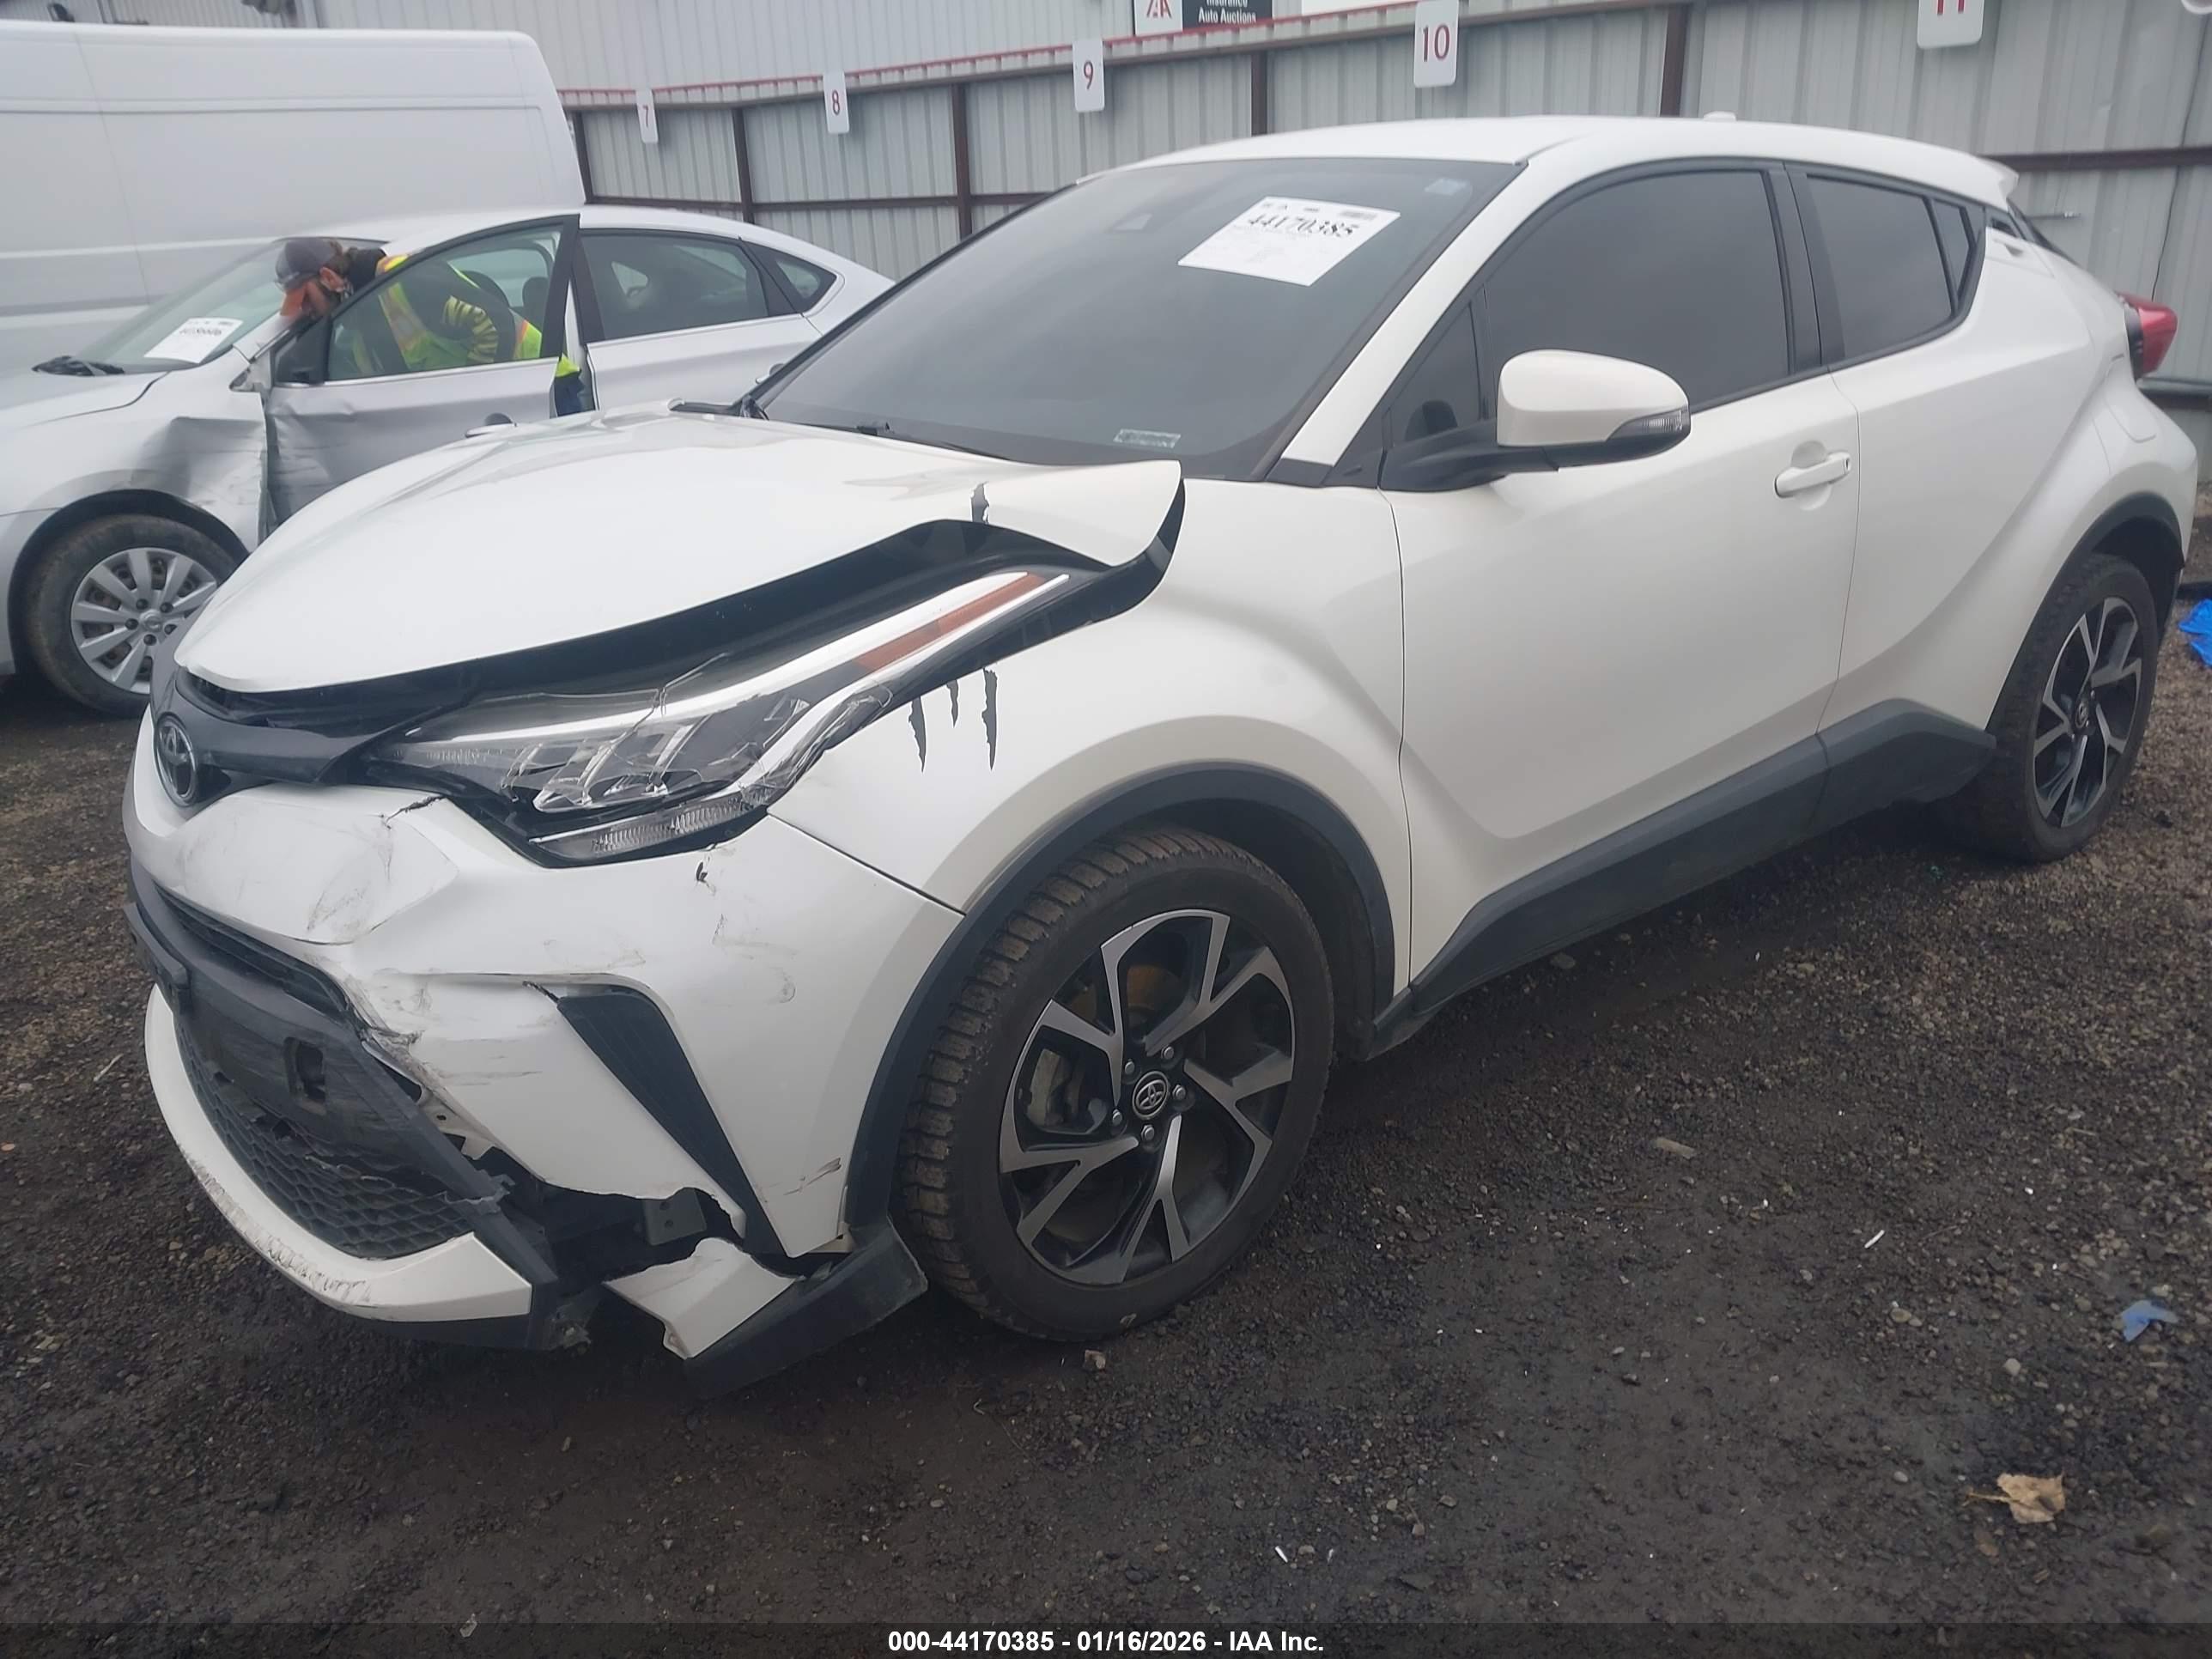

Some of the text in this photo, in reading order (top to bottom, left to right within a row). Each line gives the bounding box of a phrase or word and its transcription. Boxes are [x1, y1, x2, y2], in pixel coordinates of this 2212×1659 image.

[1198, 7, 1256, 25] Auto Auctions
[1422, 24, 1450, 63] 10
[1083, 60, 1094, 90] 9
[641, 104, 649, 128] 7
[831, 89, 841, 116] 8
